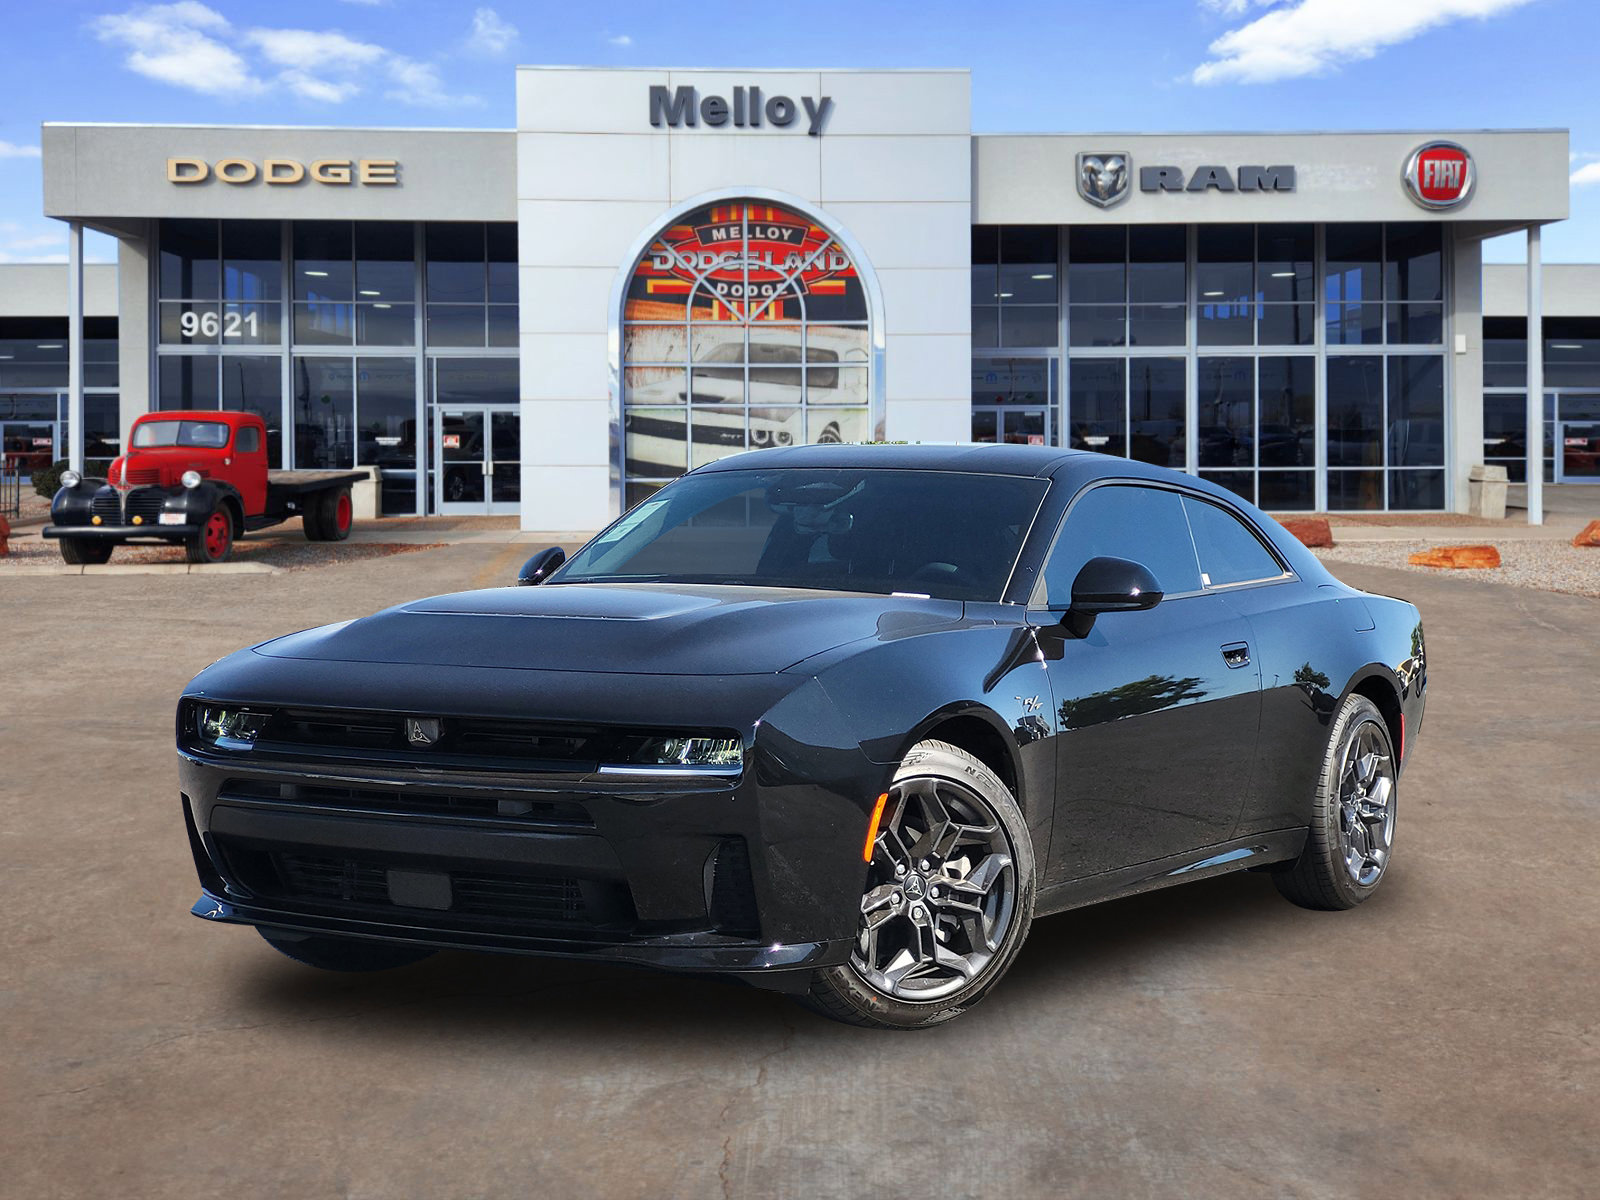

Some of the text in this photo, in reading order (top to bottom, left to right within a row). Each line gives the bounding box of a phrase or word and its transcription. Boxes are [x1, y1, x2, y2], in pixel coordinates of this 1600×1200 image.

[648, 85, 832, 137] Melloy
[166, 158, 398, 184] DODGE
[1140, 165, 1296, 191] RAM
[1423, 160, 1464, 189] FIAT
[180, 311, 257, 337] 9621
